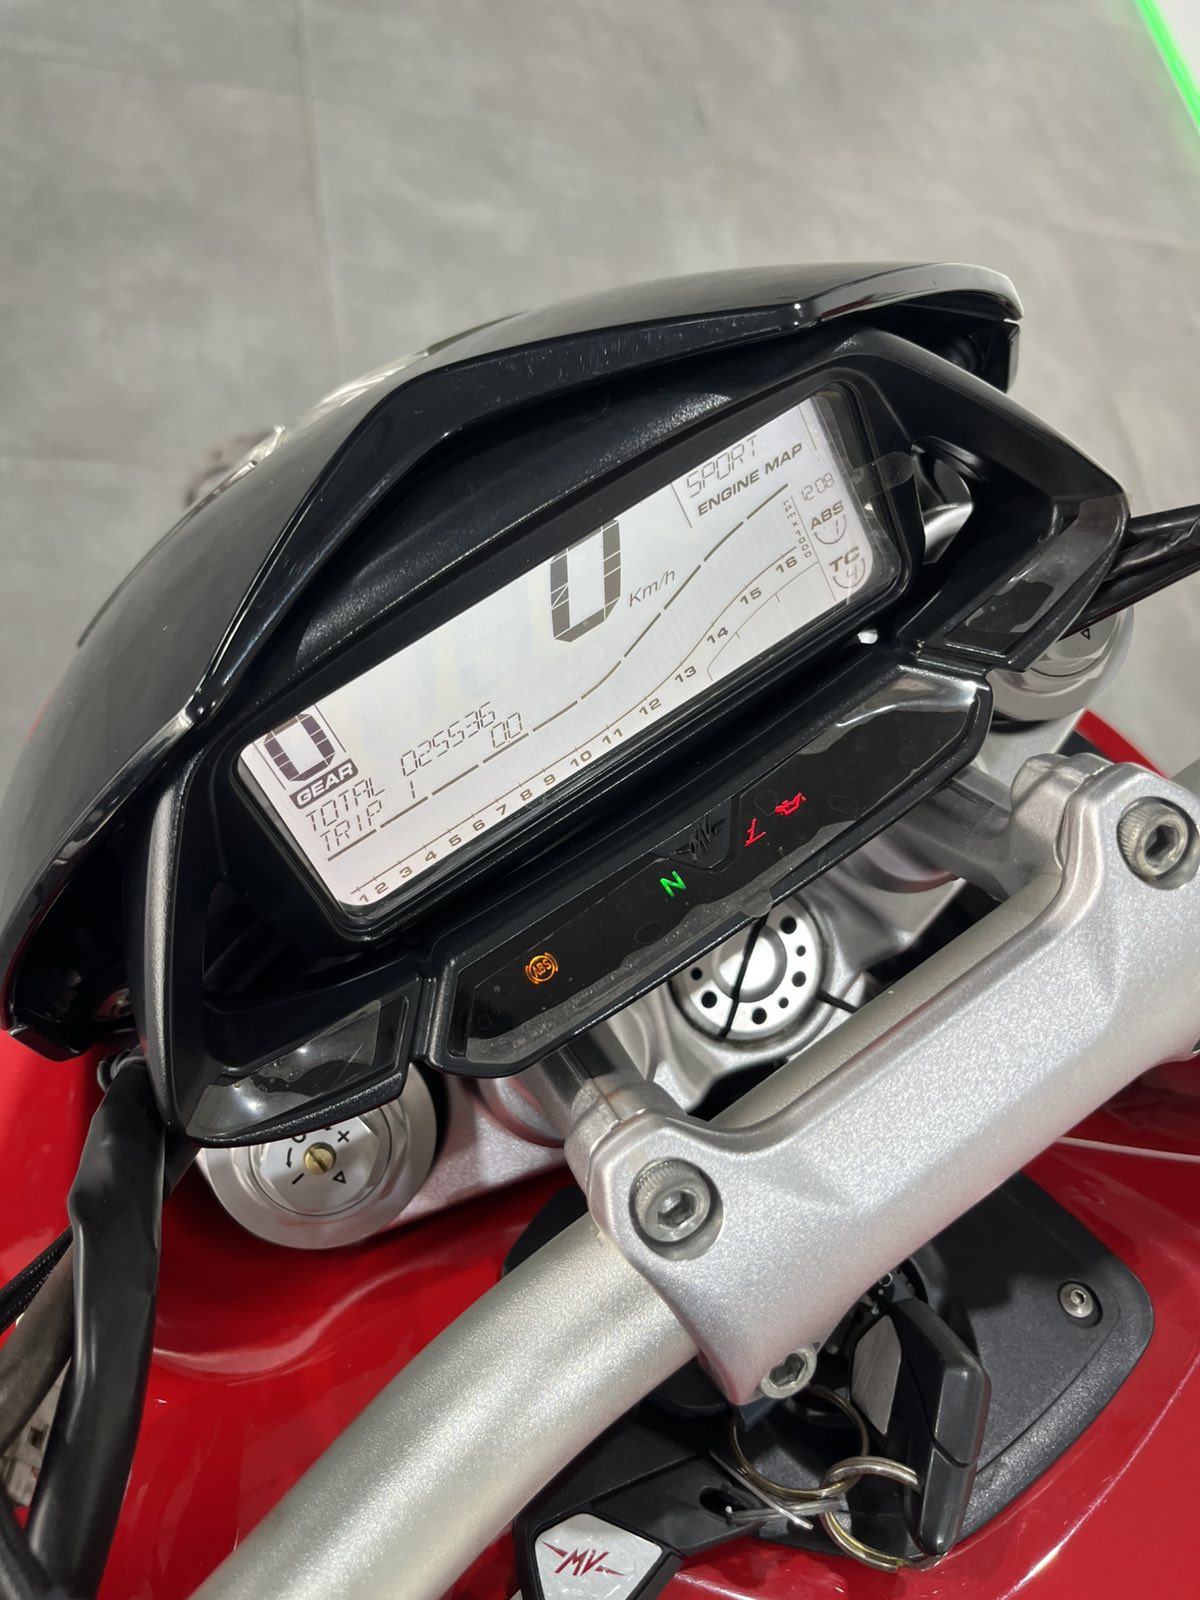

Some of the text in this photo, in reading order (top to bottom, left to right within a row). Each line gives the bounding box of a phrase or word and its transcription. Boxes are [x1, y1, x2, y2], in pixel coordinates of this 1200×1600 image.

[686, 434, 757, 498] SPORT
[698, 442, 803, 517] ENGINE MAP
[811, 500, 844, 530] ABS
[550, 519, 676, 642] 0 Km/h
[829, 546, 860, 572] TC
[263, 713, 336, 782] 0
[374, 882, 389, 895] 2
[399, 866, 413, 878] 3
[424, 850, 437, 863] 4
[448, 835, 463, 847] 5
[472, 819, 486, 832] 6
[496, 804, 508, 817] 7
[519, 789, 533, 801] 8
[543, 774, 556, 786] 9
[569, 750, 593, 767] 10
[601, 728, 624, 745] 11
[639, 698, 662, 716] 12
[674, 665, 697, 683] 13
[706, 627, 729, 644] 14
[740, 587, 762, 605] 15
[776, 556, 797, 573] 16
[295, 760, 355, 806] GEAR
[305, 700, 496, 832] TOTAL 025536
[320, 800, 382, 852] TRIP
[659, 870, 687, 898] N
[532, 958, 552, 978] ABS
